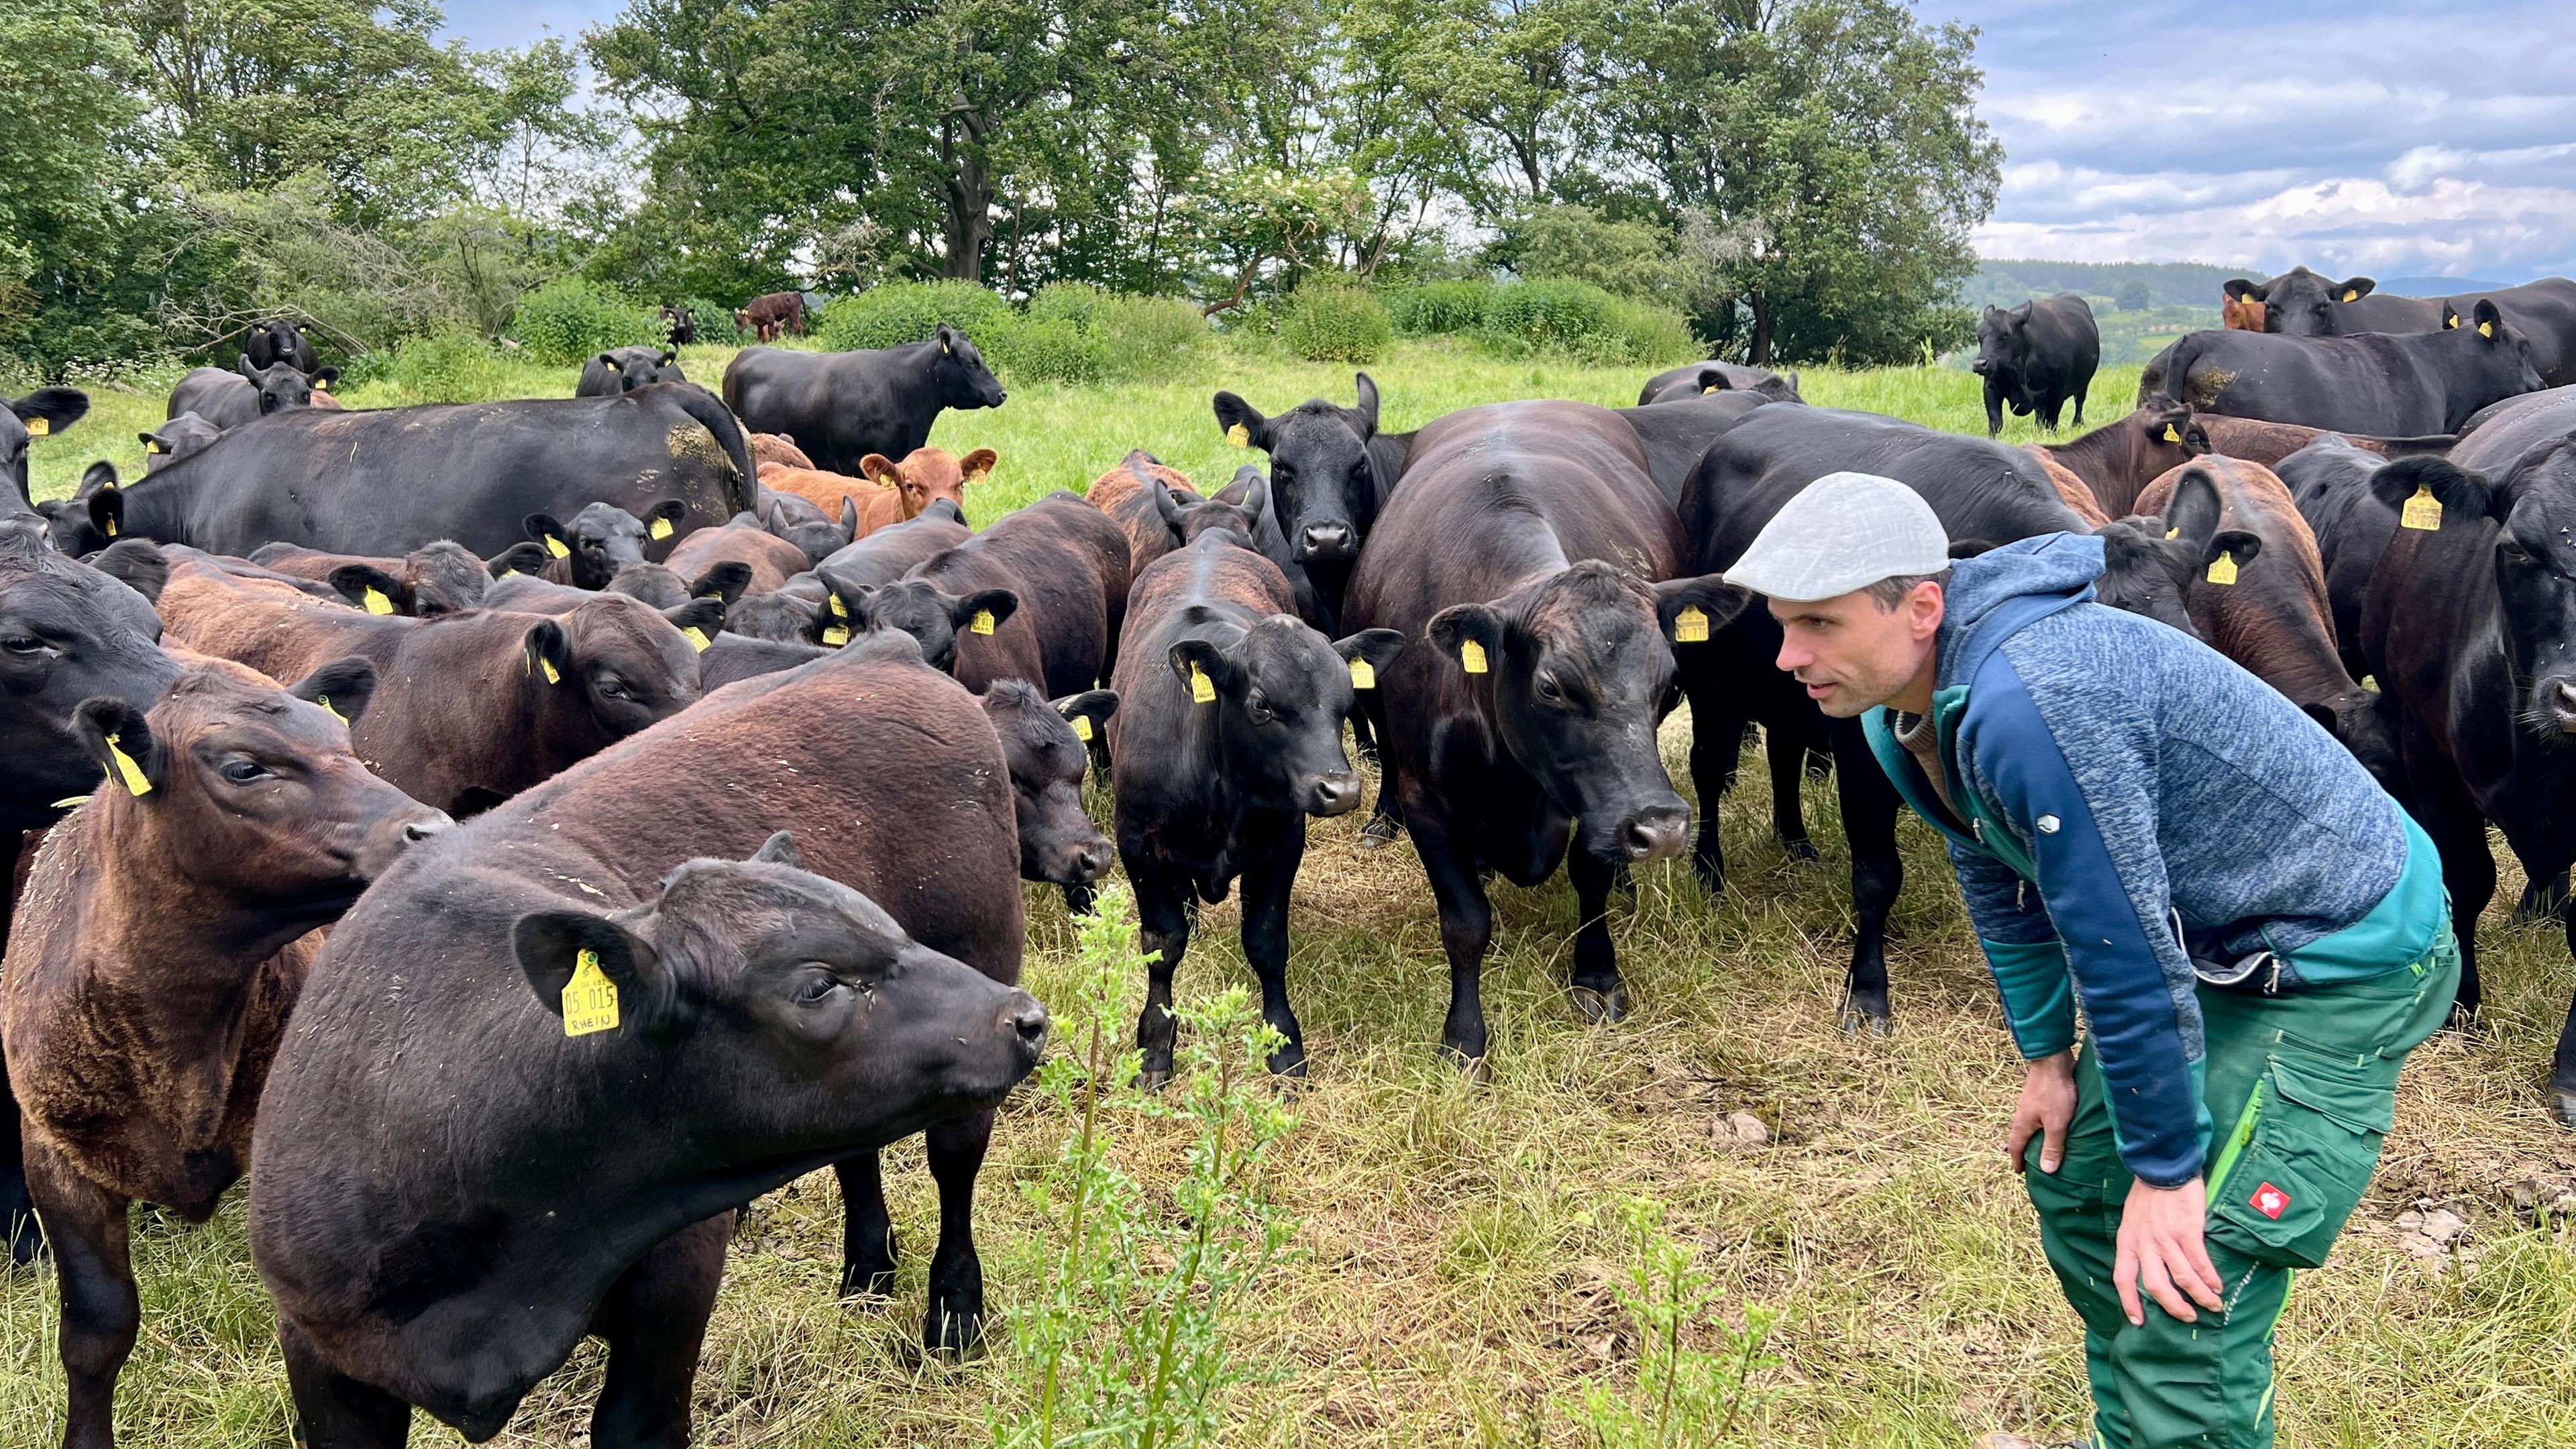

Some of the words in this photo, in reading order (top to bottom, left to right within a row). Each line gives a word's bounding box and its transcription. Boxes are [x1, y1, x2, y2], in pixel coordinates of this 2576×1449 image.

[1692, 627, 1707, 639] 770
[1074, 718, 1087, 731] 007
[565, 991, 580, 1015] 05
[590, 985, 613, 1010] 015
[572, 1014, 610, 1030] RHEIN
